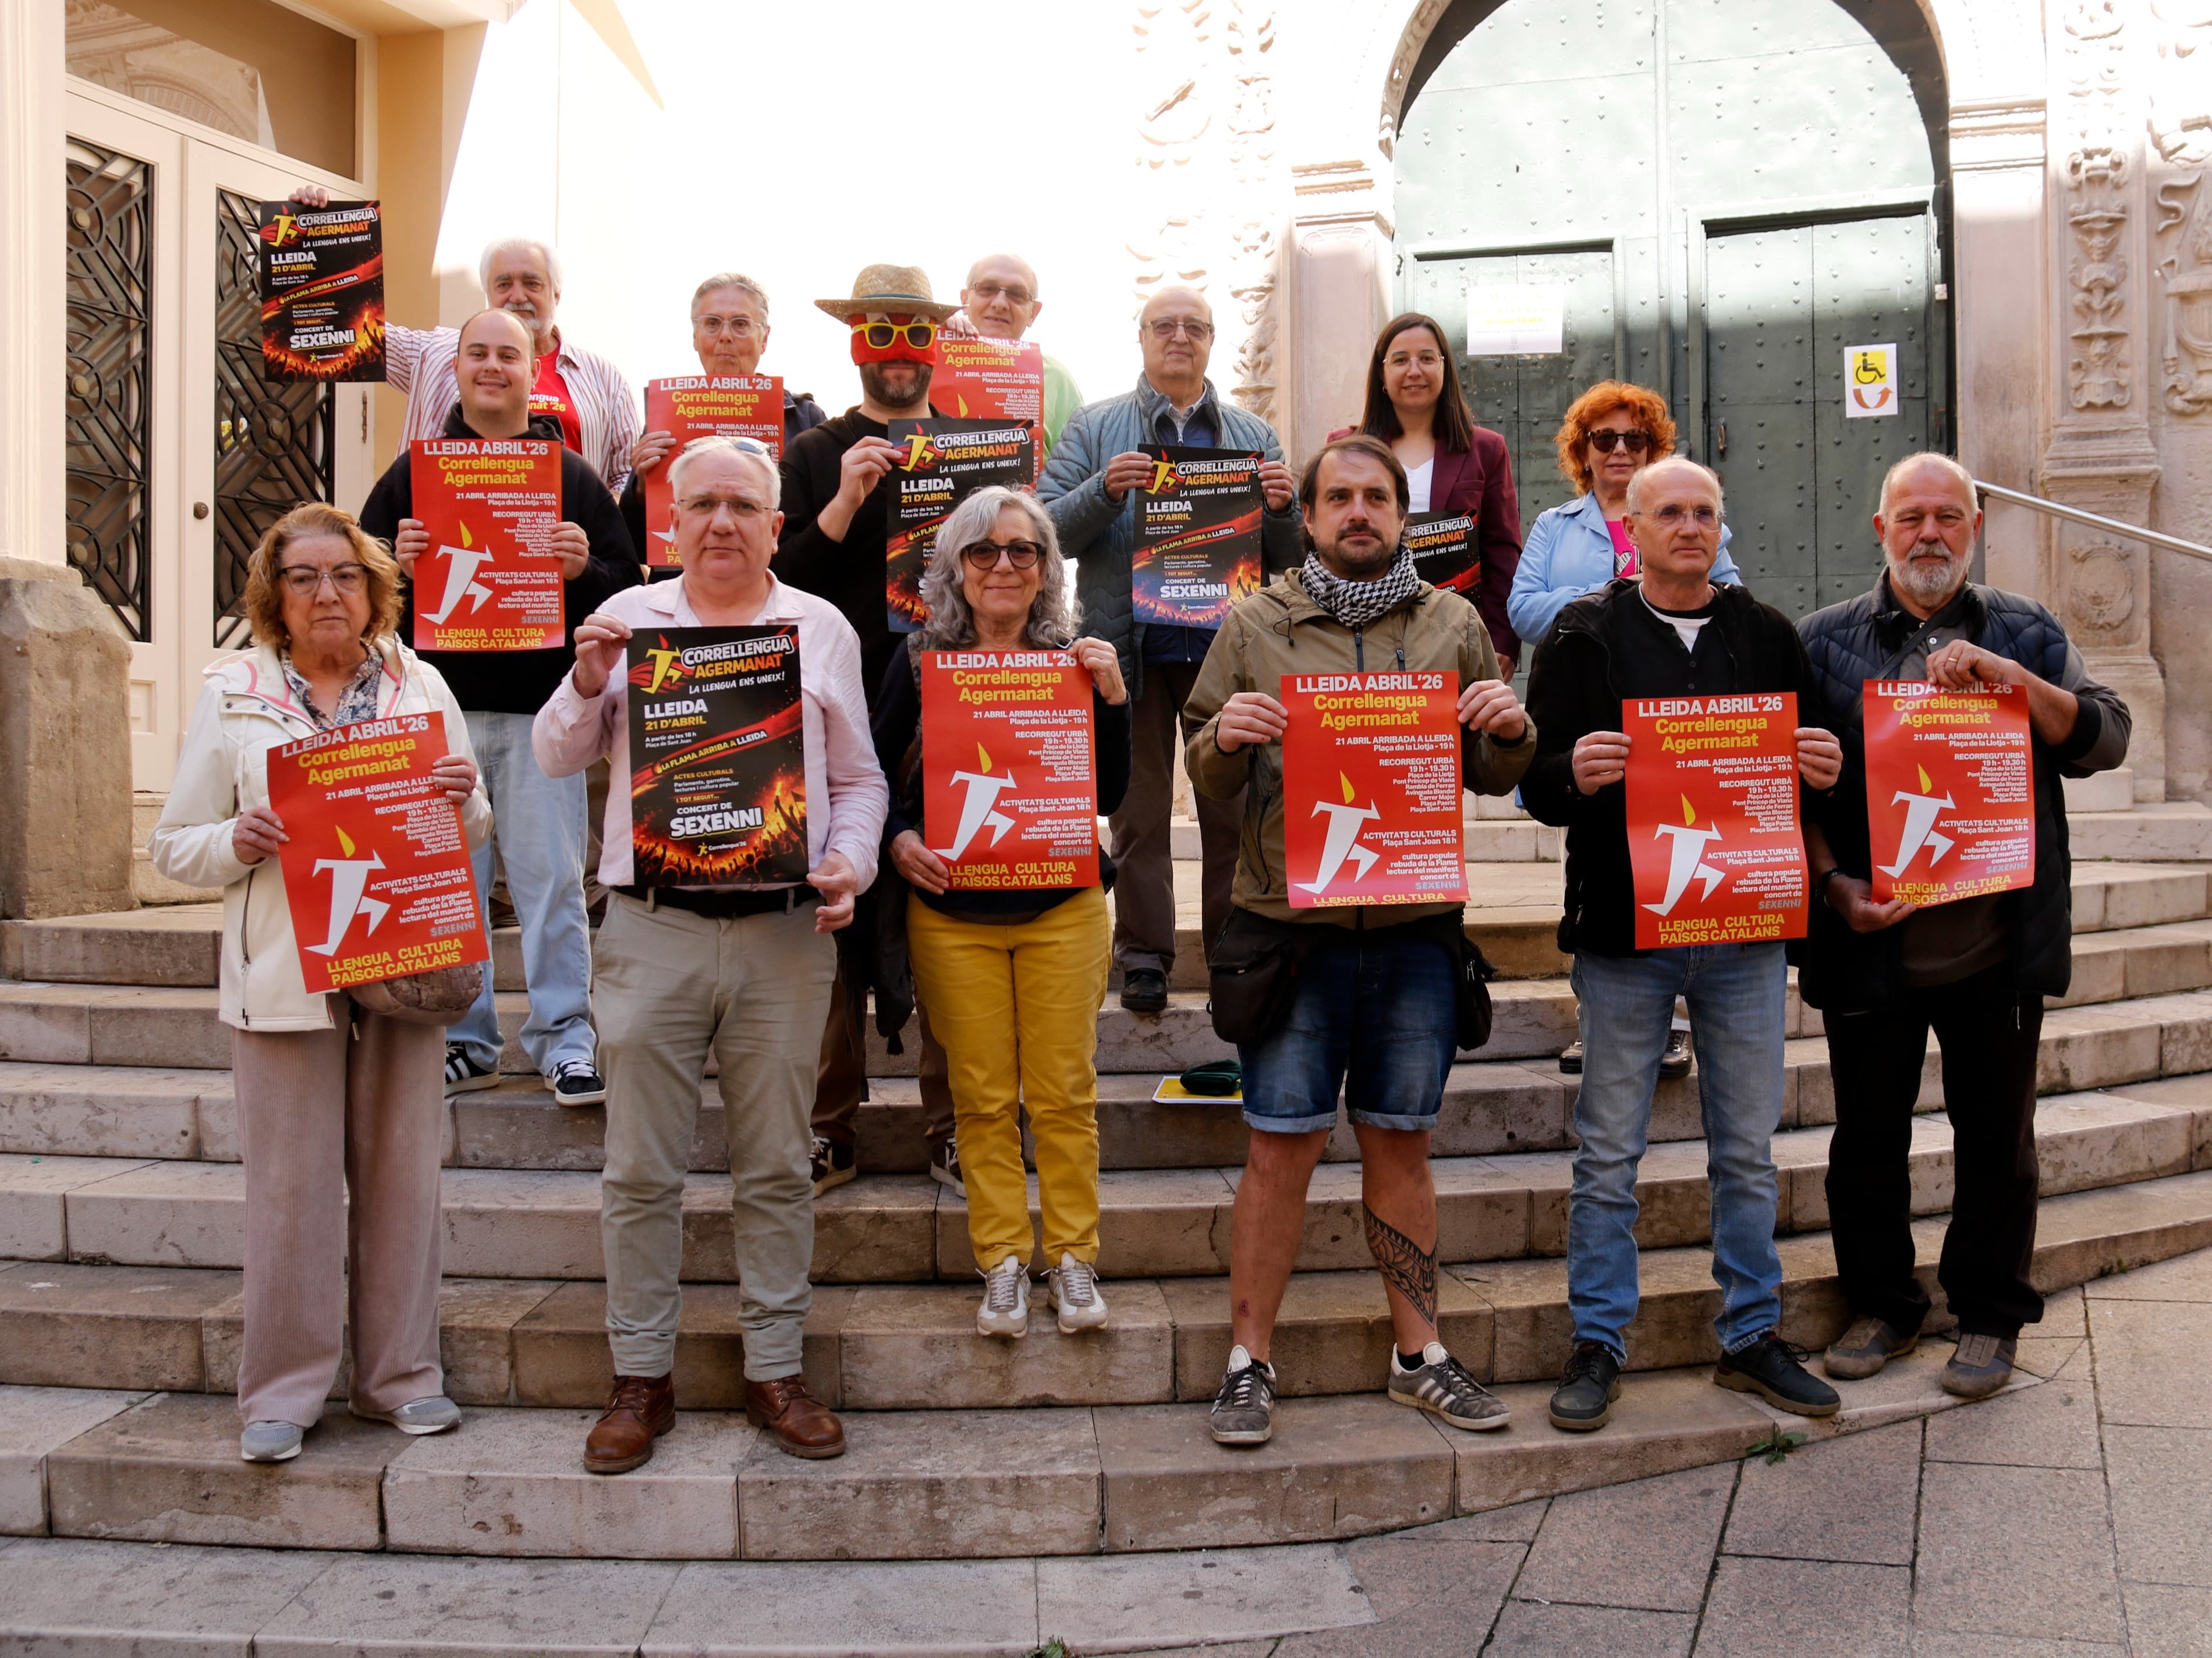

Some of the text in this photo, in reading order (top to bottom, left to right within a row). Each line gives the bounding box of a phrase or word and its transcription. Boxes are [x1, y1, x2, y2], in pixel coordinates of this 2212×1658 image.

[299, 210, 375, 226] CORRELLENGUA
[307, 221, 370, 237] AGERMANAT
[271, 251, 317, 265] LLEIDA
[283, 264, 316, 272] D'ABRIL
[290, 330, 355, 349] SEXENNI
[941, 342, 1020, 356] Correllengua
[945, 354, 1015, 367] Agermanat
[660, 377, 708, 390] LLEIDA
[672, 391, 758, 403] Correllengua
[676, 404, 752, 417] Agermanat
[937, 431, 1026, 448] CORRELLENGUA
[424, 442, 478, 455] LLEIDA
[945, 442, 1019, 460] AGERMANAT
[439, 456, 534, 472] Correllengua
[1178, 460, 1257, 474] CORRELLENGUA
[444, 472, 527, 487] Agermanat
[901, 477, 954, 493] LLEIDA
[1185, 472, 1250, 485] AGERMANAT
[902, 493, 952, 504] 21 D'ABRIL
[1146, 501, 1193, 513] LLEIDA
[1157, 513, 1191, 521] D'ABRIL
[1448, 543, 1467, 552] UNEIX!
[1160, 583, 1227, 598] SEXENNI
[435, 628, 545, 638] LLENGUA CULTURA
[436, 635, 541, 648] PAÏSOS CATALANS
[683, 637, 791, 664] CORRELLENGUA
[694, 653, 784, 678] AGERMANAT
[937, 654, 999, 668] LLEIDA
[689, 671, 785, 694] LA LLENGUA ENS UNEIX!
[953, 670, 1062, 688] Correllengua
[1297, 676, 1362, 692] LLEIDA
[959, 686, 1054, 704] Agermanat
[1878, 683, 1937, 696] LLEIDA
[644, 699, 708, 718] LLEIDA
[1314, 693, 1427, 713] Correllengua
[1639, 700, 1703, 717] LLEIDA
[1893, 698, 1997, 712] Correllengua
[645, 715, 706, 730] 21 D'ABRIL
[1321, 710, 1419, 731] Agermanat
[1656, 717, 1767, 734] Correllengua
[1899, 712, 1991, 728] Agermanat
[282, 730, 348, 758] LLEIDA
[669, 752, 698, 767] FLAMA
[698, 742, 729, 757] ARRIBA
[736, 731, 767, 745] LLEIDA
[1661, 734, 1758, 753] Agermanat
[299, 738, 416, 768] Correllengua
[1713, 757, 1754, 766] ARRIBADA
[308, 755, 410, 785] Agermanat
[696, 768, 733, 777] CULTURALS
[1720, 777, 1792, 788] RECORREGUT URBÀ
[676, 803, 718, 814] CONCERT
[669, 807, 763, 837] SEXENNI
[1410, 830, 1456, 838] CULTURALS
[708, 841, 746, 851] Correllengua'26
[1708, 848, 1798, 859] ACTIVITATS CULTURALS
[950, 862, 1076, 876] LLENGUA CULTURA
[1774, 869, 1801, 878] popular
[371, 868, 466, 891] ACTIVITATS CULTURALS
[952, 872, 1072, 886] PAÏSOS CATALANS
[1892, 875, 2011, 894] LLENGUA CULTURA
[1313, 893, 1446, 905] LLENGUA CULTURA
[1759, 899, 1801, 909] SEXENNI
[1659, 914, 1785, 932] LLENGUA CULTURA
[1660, 926, 1780, 944] PAÏSOS CATALANS
[327, 938, 463, 973] LLENGUA CULTURA
[330, 951, 460, 985] PAÏSOS CATALANS
